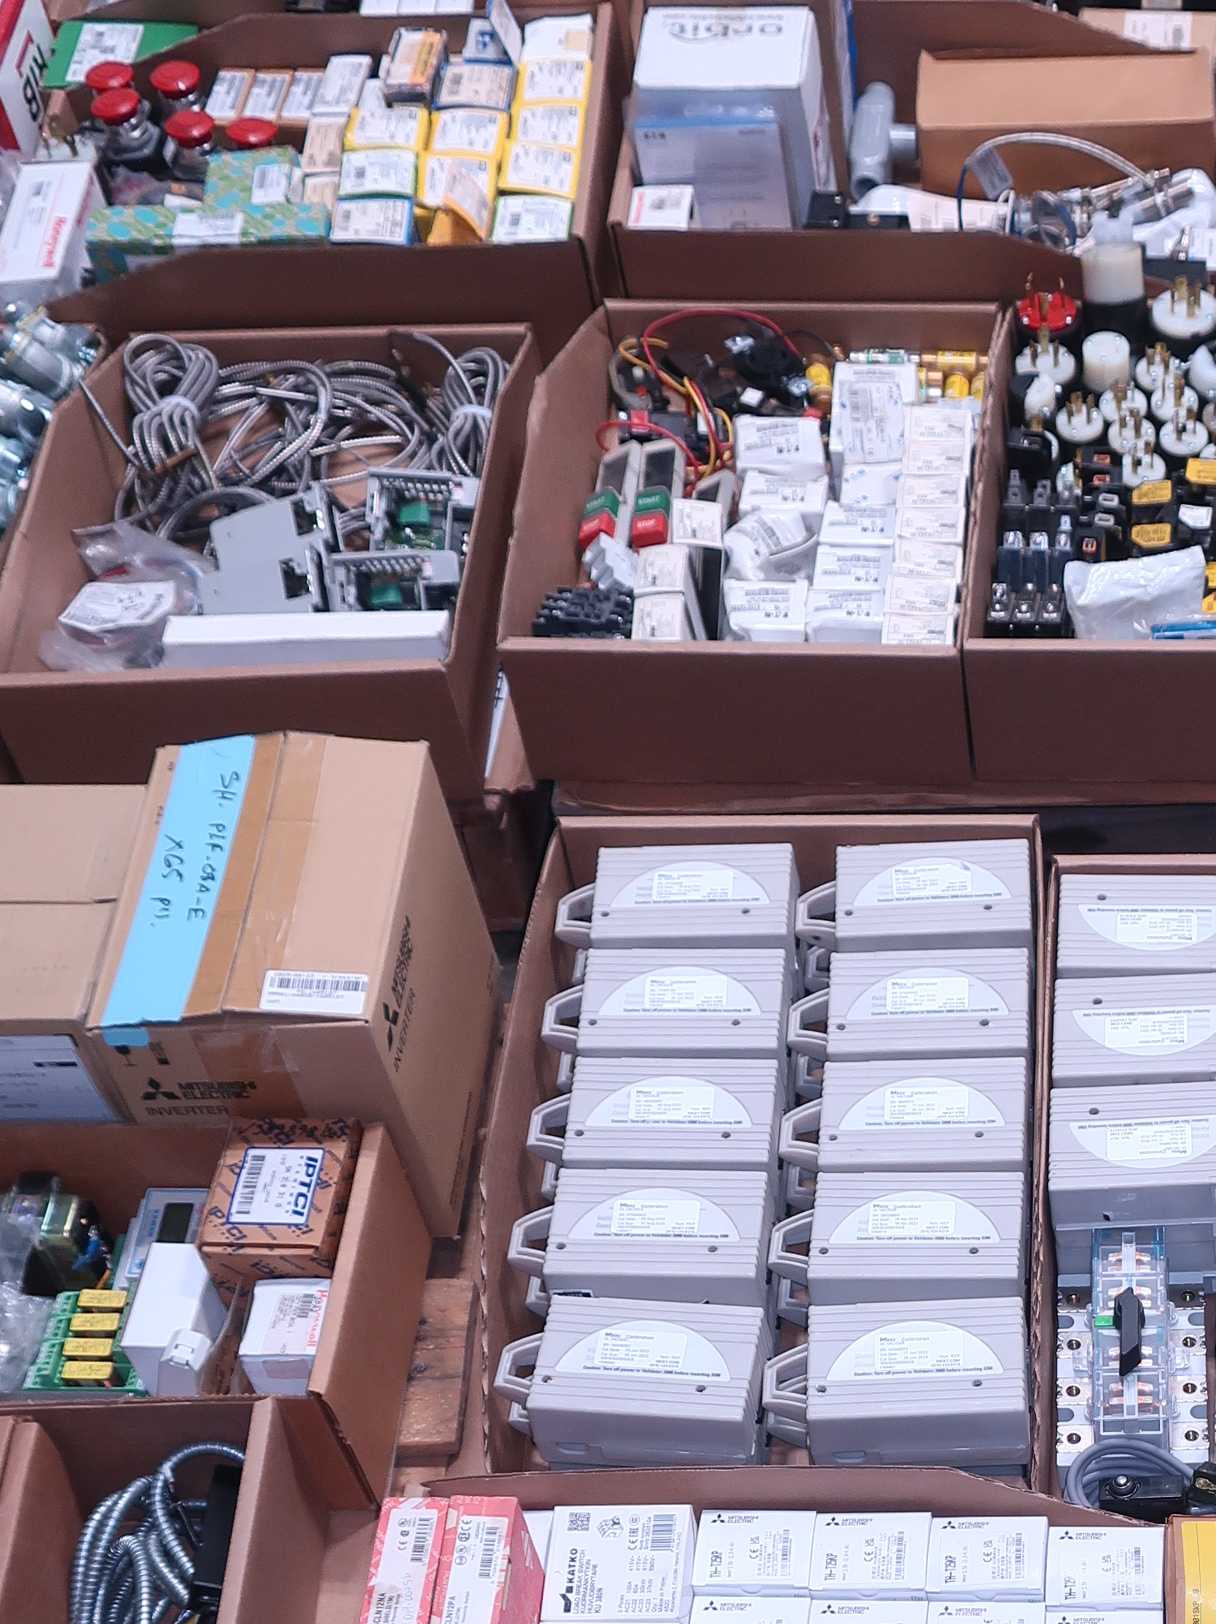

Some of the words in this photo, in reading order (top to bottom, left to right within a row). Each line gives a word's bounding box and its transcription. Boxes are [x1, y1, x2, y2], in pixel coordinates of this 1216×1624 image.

[393, 988, 416, 1072] INVERTER
[145, 1104, 230, 1117] INVERTER
[291, 1155, 320, 1217] IPTCI
[566, 1548, 578, 1584] KATKO
